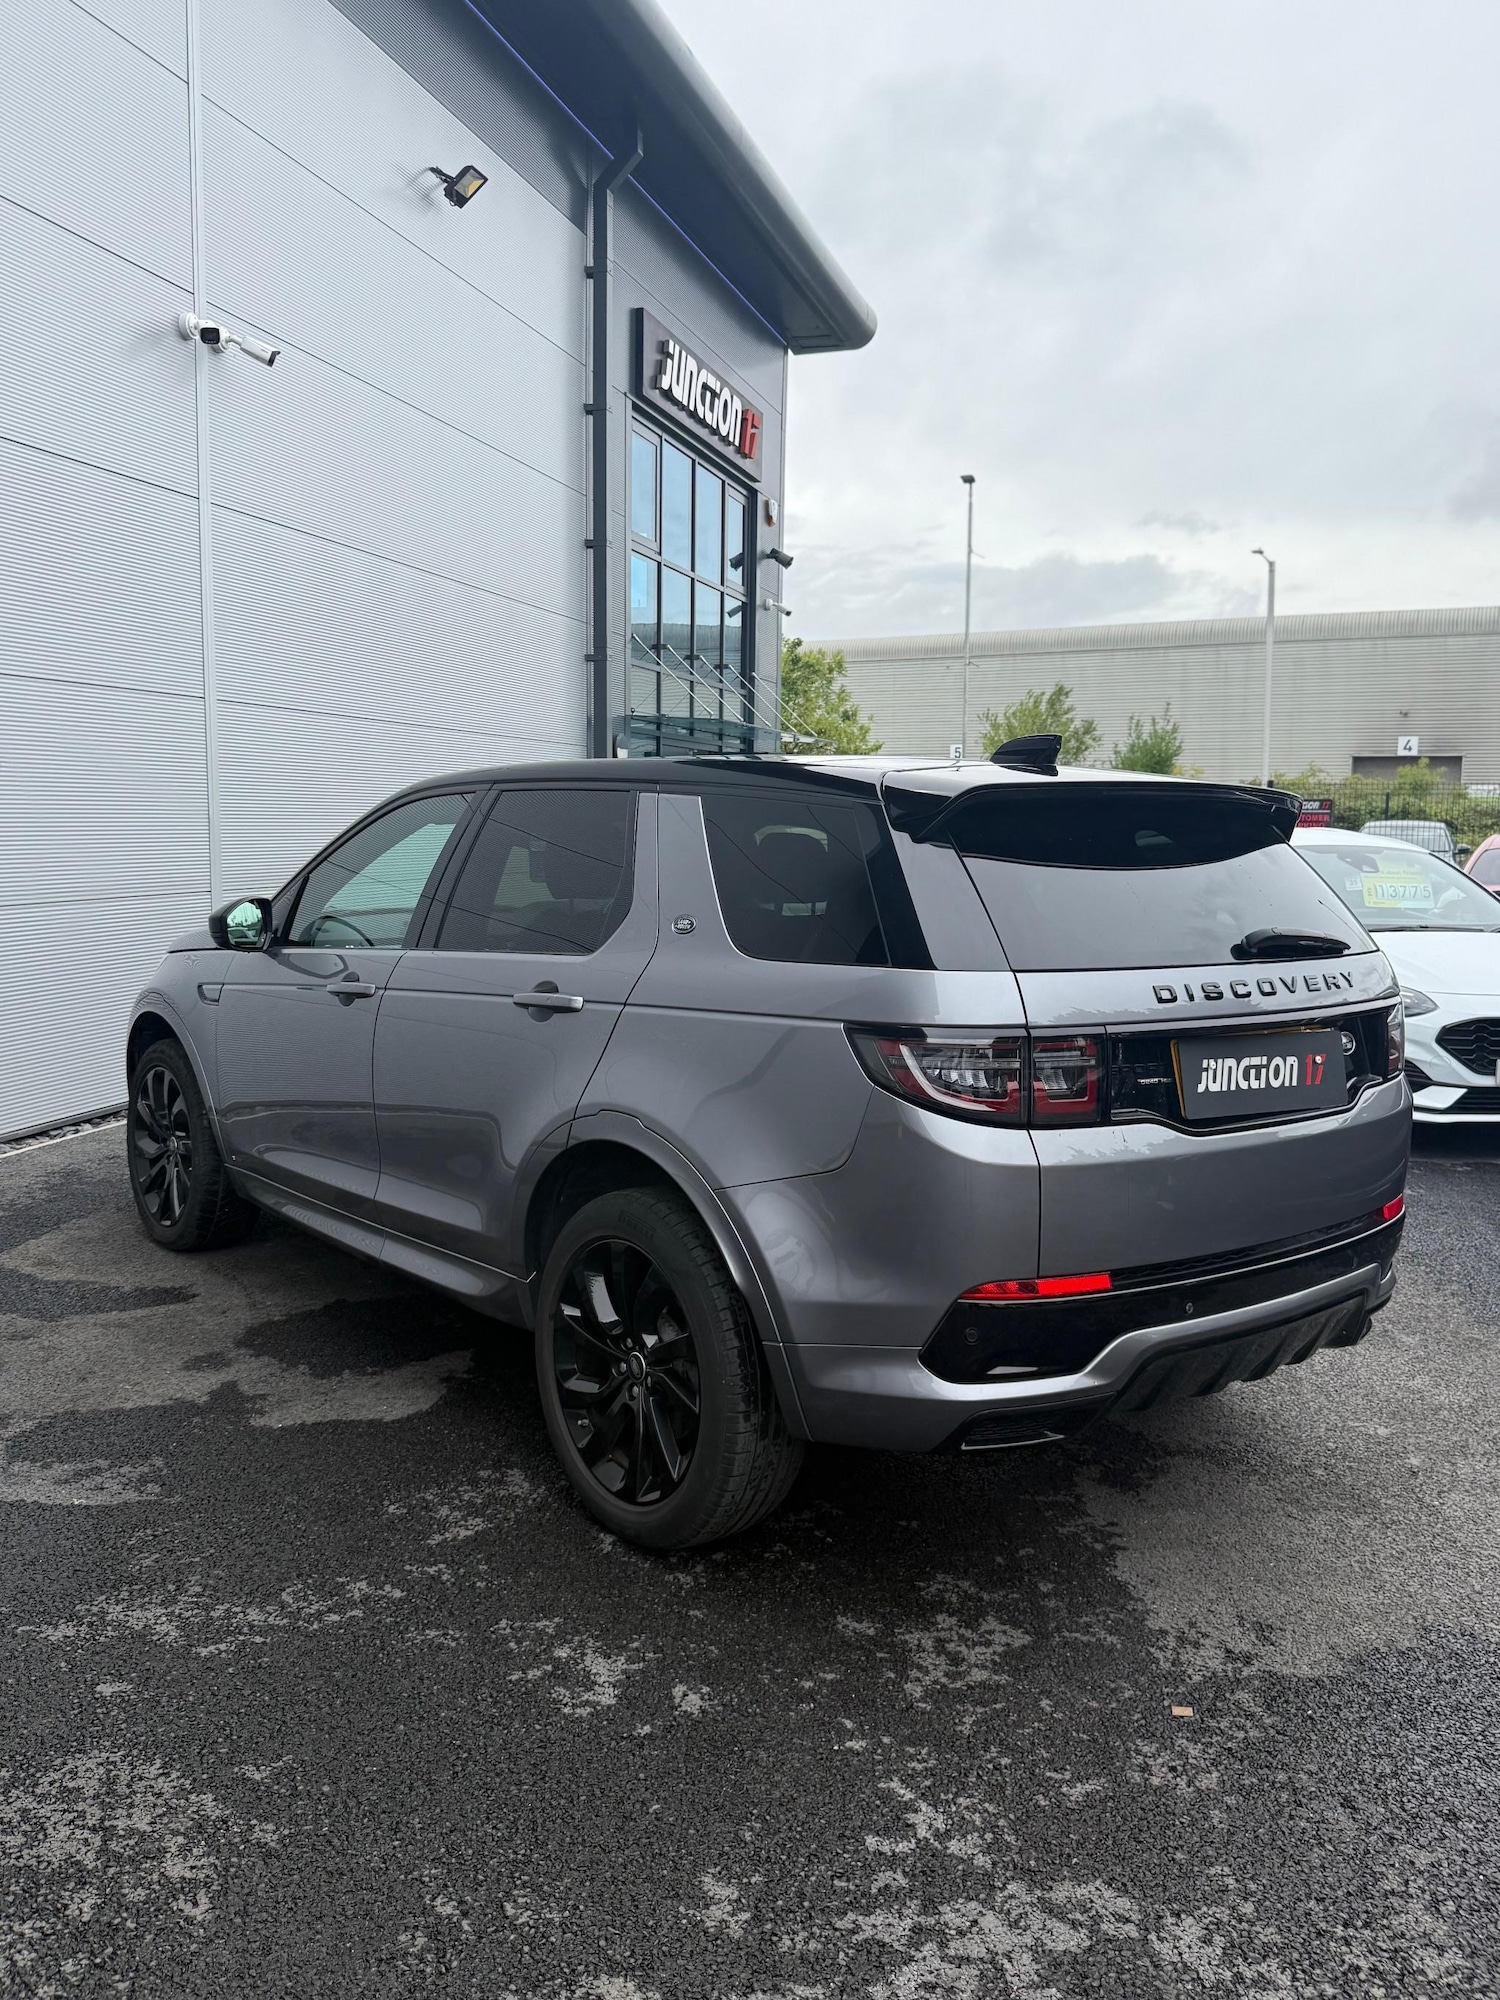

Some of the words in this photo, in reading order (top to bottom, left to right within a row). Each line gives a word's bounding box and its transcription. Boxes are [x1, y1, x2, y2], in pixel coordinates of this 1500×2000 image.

[955, 747, 961, 758] 5
[1403, 739, 1413, 752] 4
[1152, 971, 1354, 1004] DISCOVERY
[1305, 1053, 1327, 1086] 17
